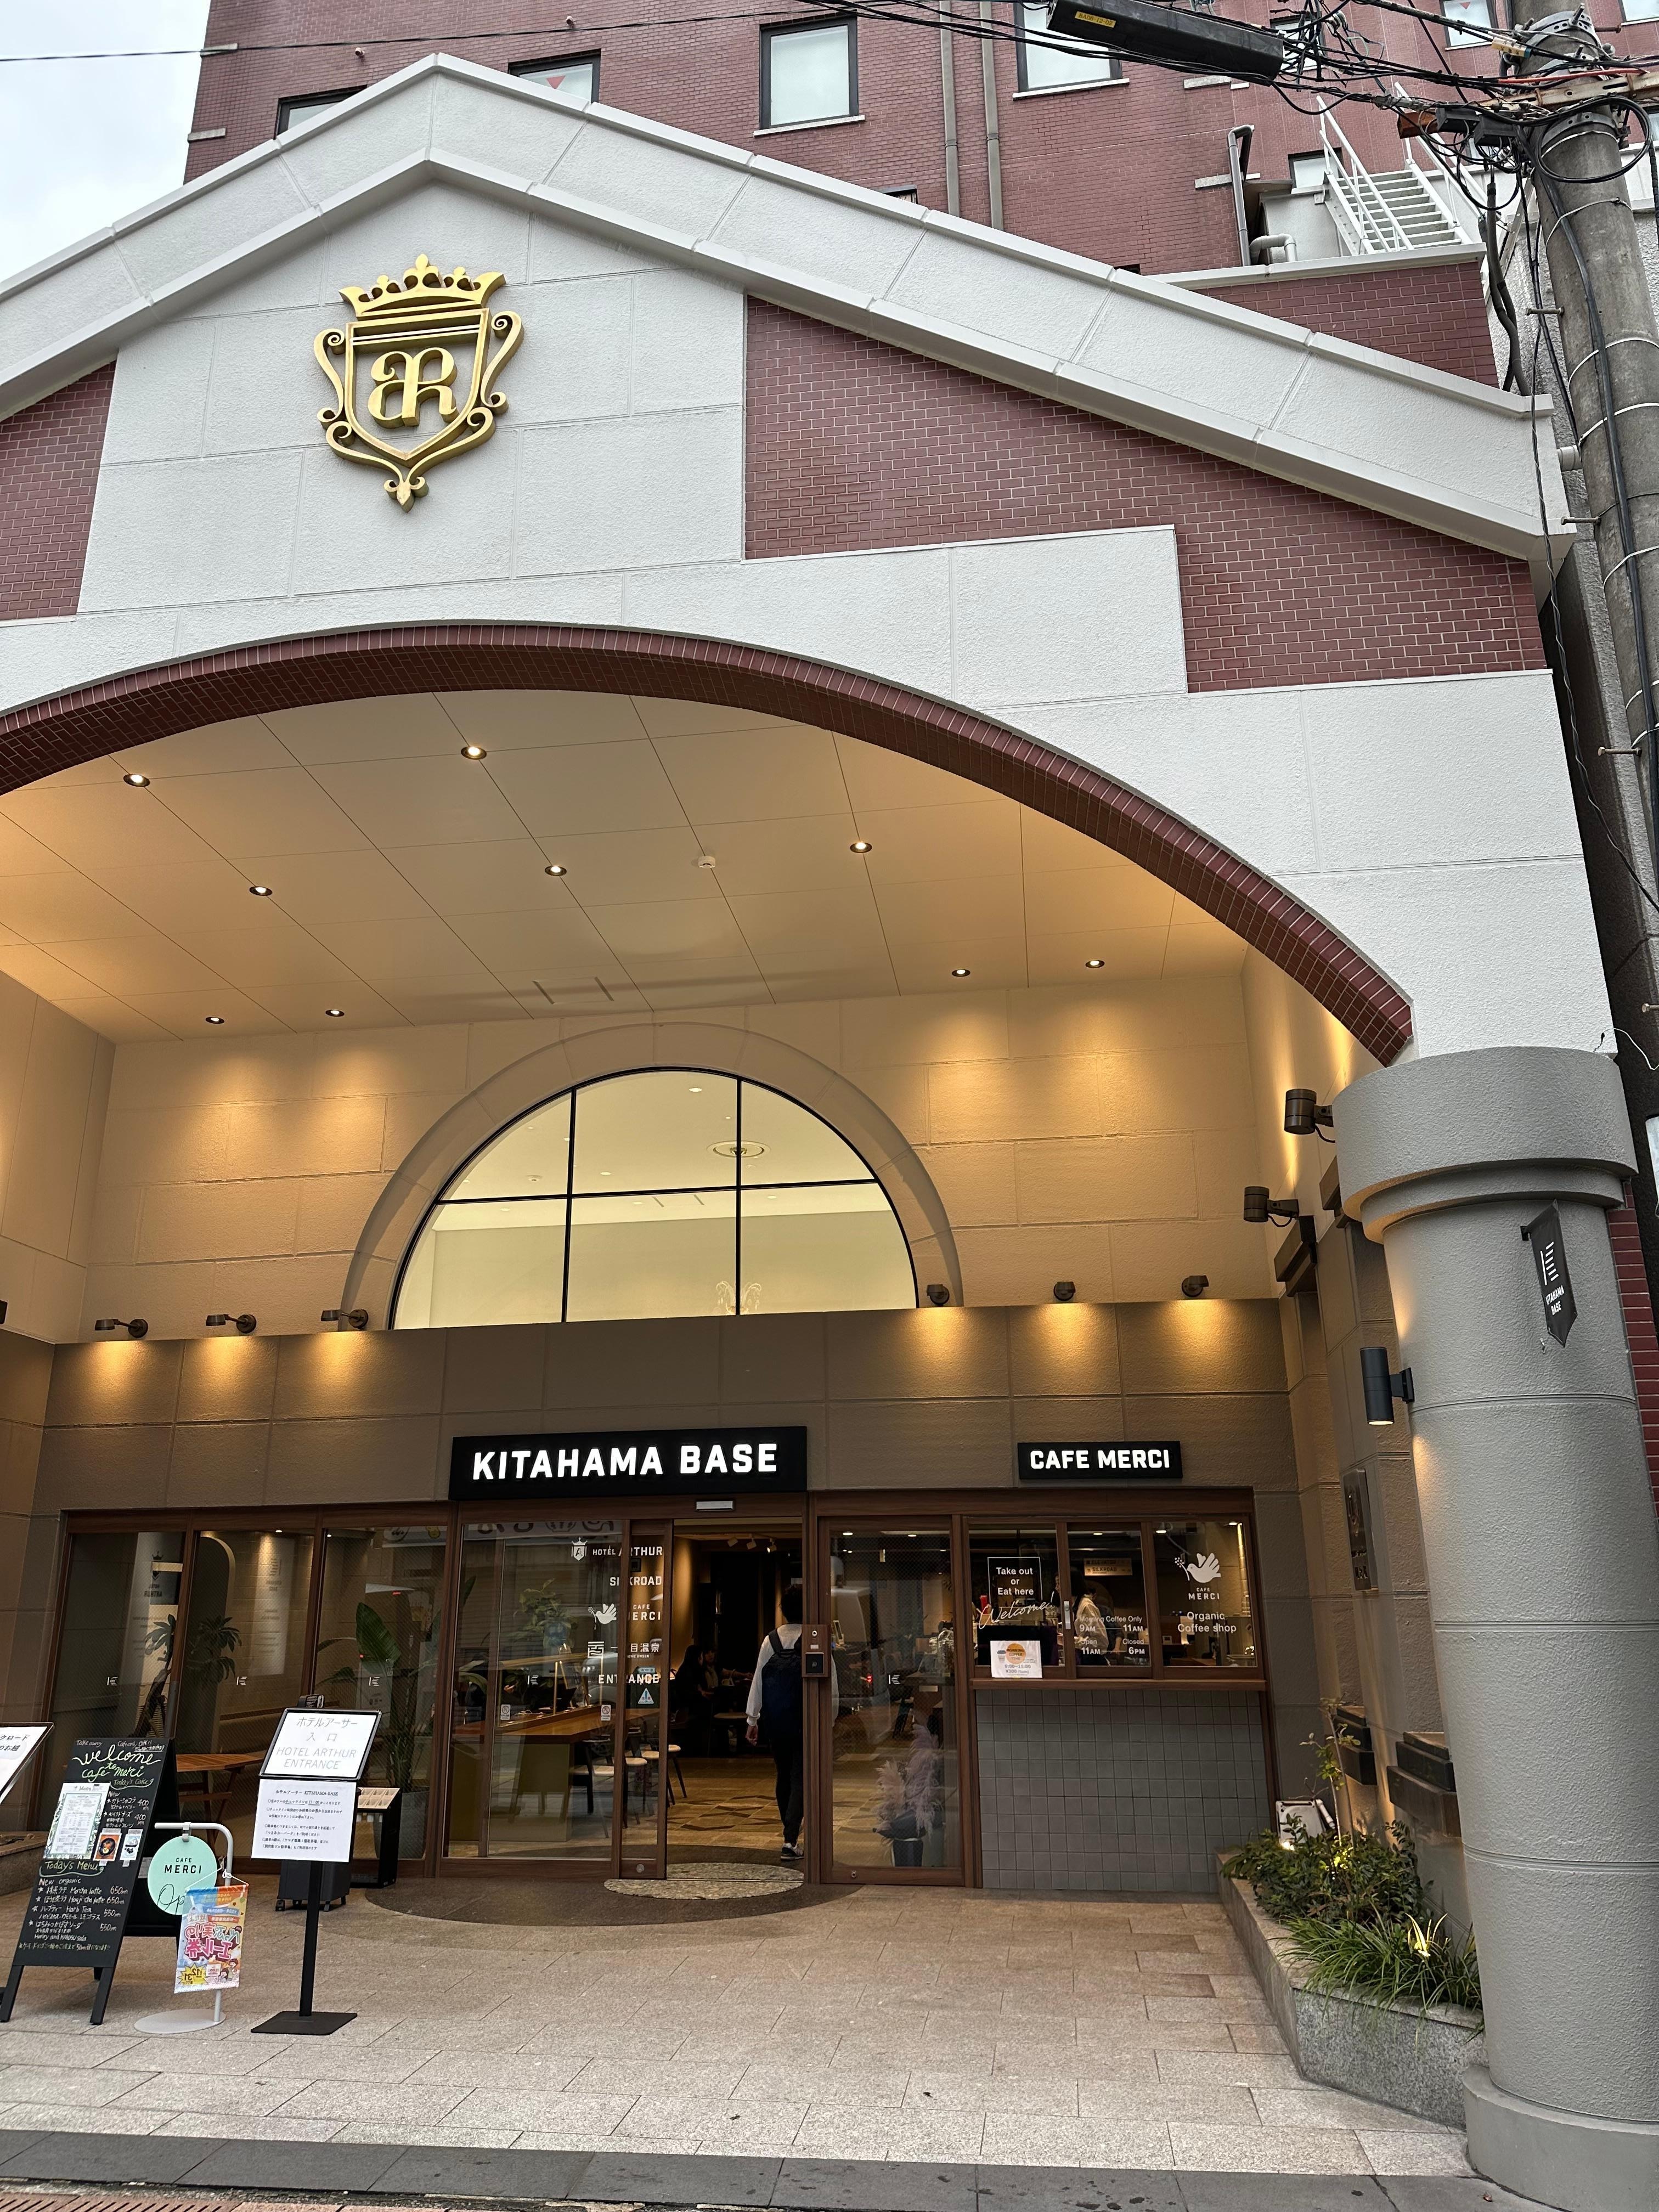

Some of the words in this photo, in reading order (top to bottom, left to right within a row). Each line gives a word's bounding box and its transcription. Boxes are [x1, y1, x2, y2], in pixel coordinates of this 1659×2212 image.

[1550, 1301, 1562, 1316] BASE
[473, 1446, 663, 1480] KITAHAMA
[680, 1443, 777, 1474] BASE
[1030, 1450, 1090, 1469] CAFE
[1097, 1449, 1170, 1469] MERCI
[618, 1547, 663, 1556] THUR
[610, 1576, 662, 1586] SIKROAD
[628, 1612, 661, 1621] ERCI
[1080, 1616, 1104, 1625] Morning
[1187, 1612, 1225, 1622] Organic
[1178, 1623, 1210, 1632] Coffee
[1213, 1623, 1237, 1633] shop
[611, 1643, 659, 1652] 一目温泉
[599, 1674, 659, 1684] ENTANCE
[296, 1717, 358, 1728] ホテルアーサー
[276, 1747, 309, 1756] HOTEL
[313, 1747, 357, 1758] ARTHUR
[106, 1762, 117, 1770] to
[284, 1759, 341, 1769] ENTRANCE
[77, 1861, 99, 1870] Menu
[165, 1865, 201, 1874] MERCI
[59, 1877, 81, 1886] organic
